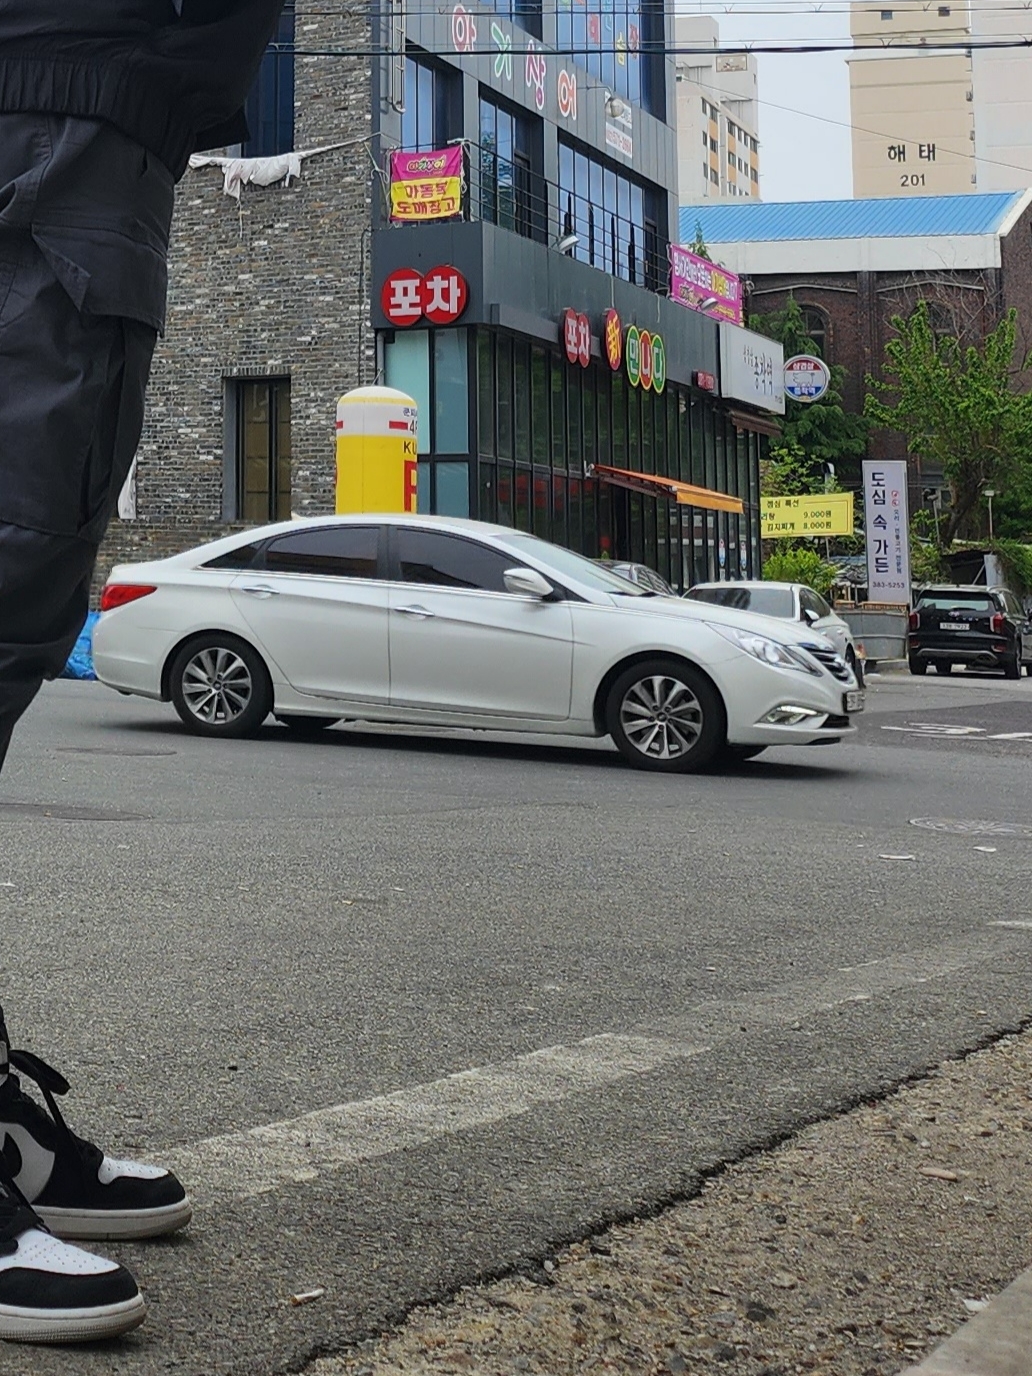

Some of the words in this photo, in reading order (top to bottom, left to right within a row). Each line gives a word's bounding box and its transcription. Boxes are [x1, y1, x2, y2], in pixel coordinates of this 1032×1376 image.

[451, 3, 578, 122] 아기상어
[887, 142, 937, 164] 해태
[900, 173, 926, 188] 201
[389, 275, 461, 317] 포차
[567, 317, 590, 361] 포차
[871, 472, 886, 506] 도심
[873, 514, 887, 530] 속
[873, 539, 889, 574] 가든
